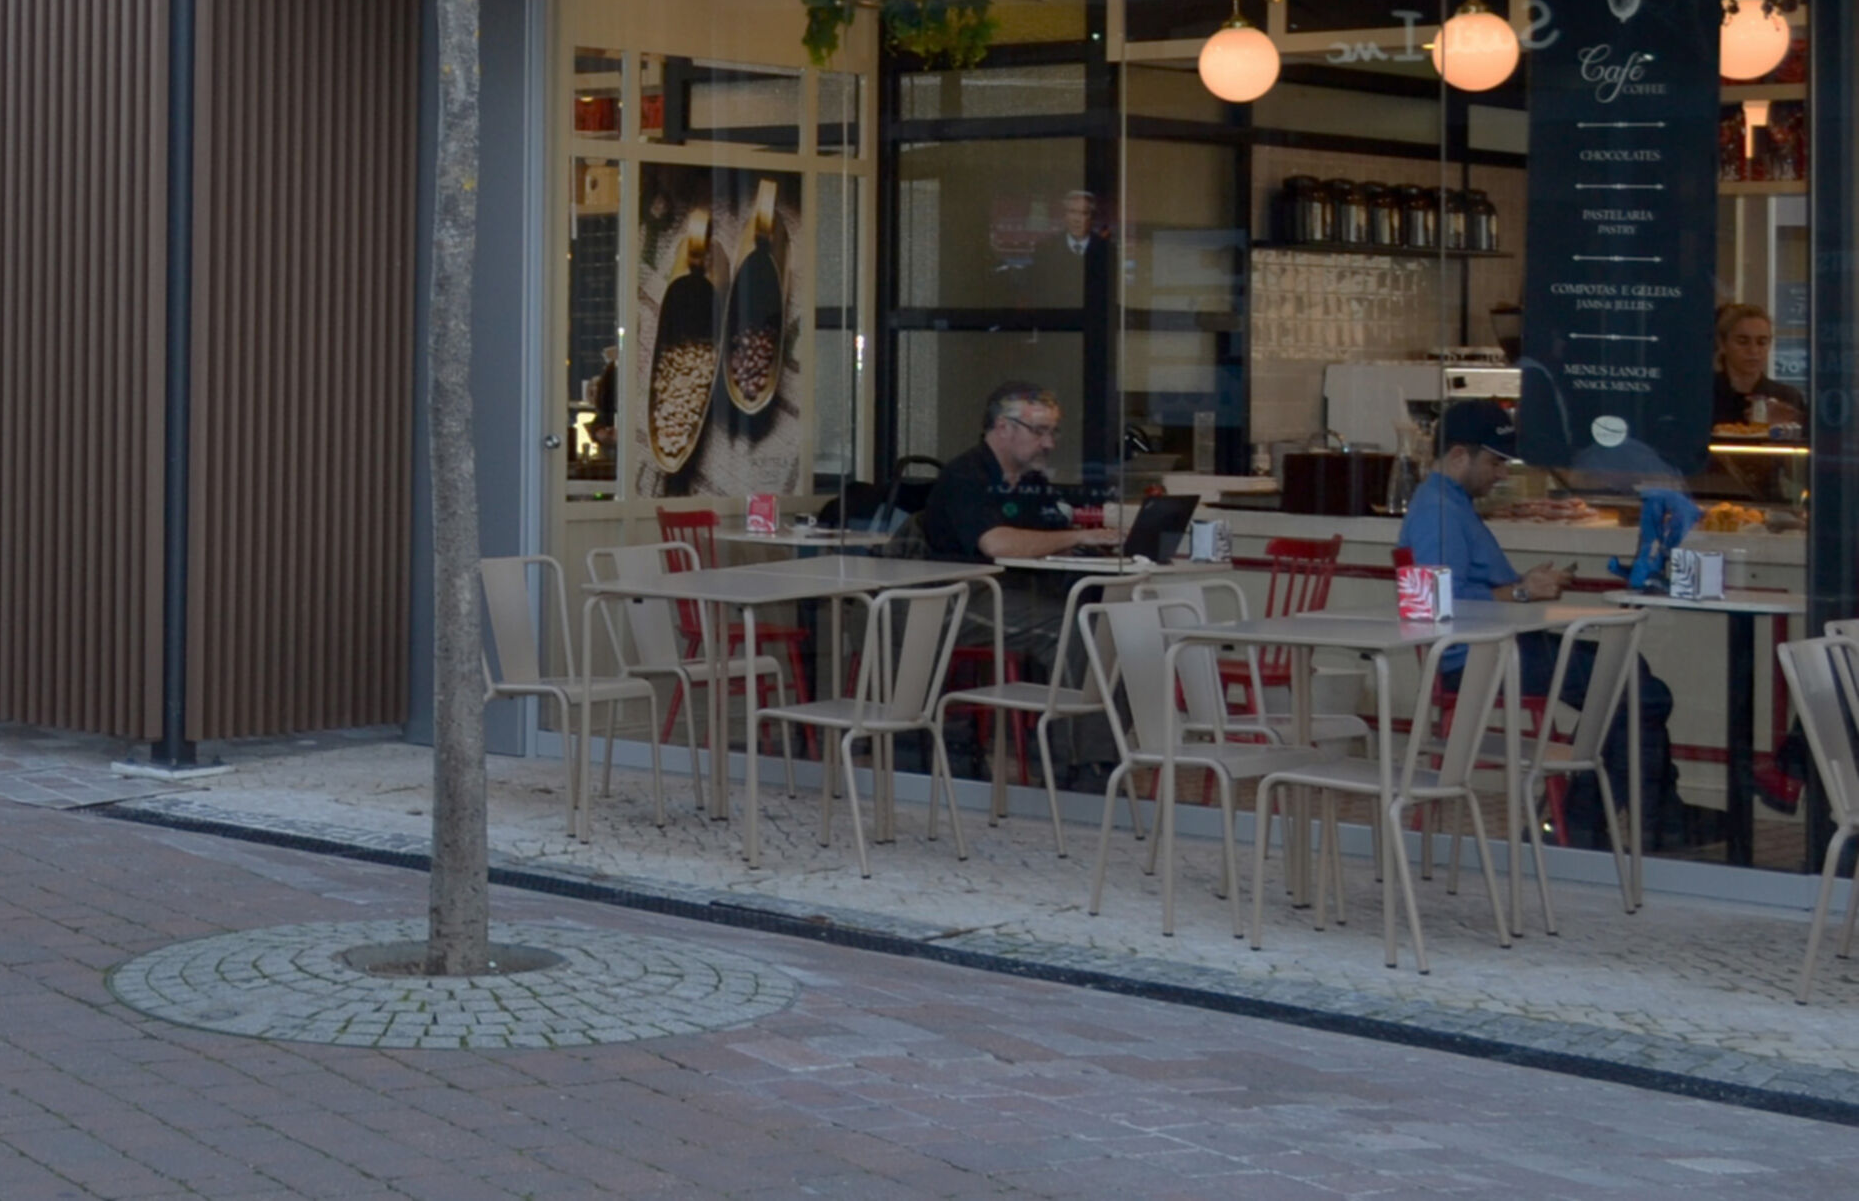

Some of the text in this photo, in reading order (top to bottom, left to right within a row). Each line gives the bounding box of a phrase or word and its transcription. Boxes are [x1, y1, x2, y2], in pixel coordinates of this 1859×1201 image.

[1577, 43, 1653, 103] Café
[1622, 84, 1667, 94] COFFEE
[1579, 149, 1661, 161] CHOCOLATES
[1582, 209, 1654, 221] PASTELARIA
[1598, 224, 1636, 235] PASTRY
[1550, 283, 1682, 298] COMPOTAS E GELEIAS
[1576, 299, 1603, 310] JAMS
[1614, 299, 1654, 311] JELLIES
[1564, 364, 1661, 379] MENUS LANCHE
[1573, 379, 1651, 392] SNACK MENUS
